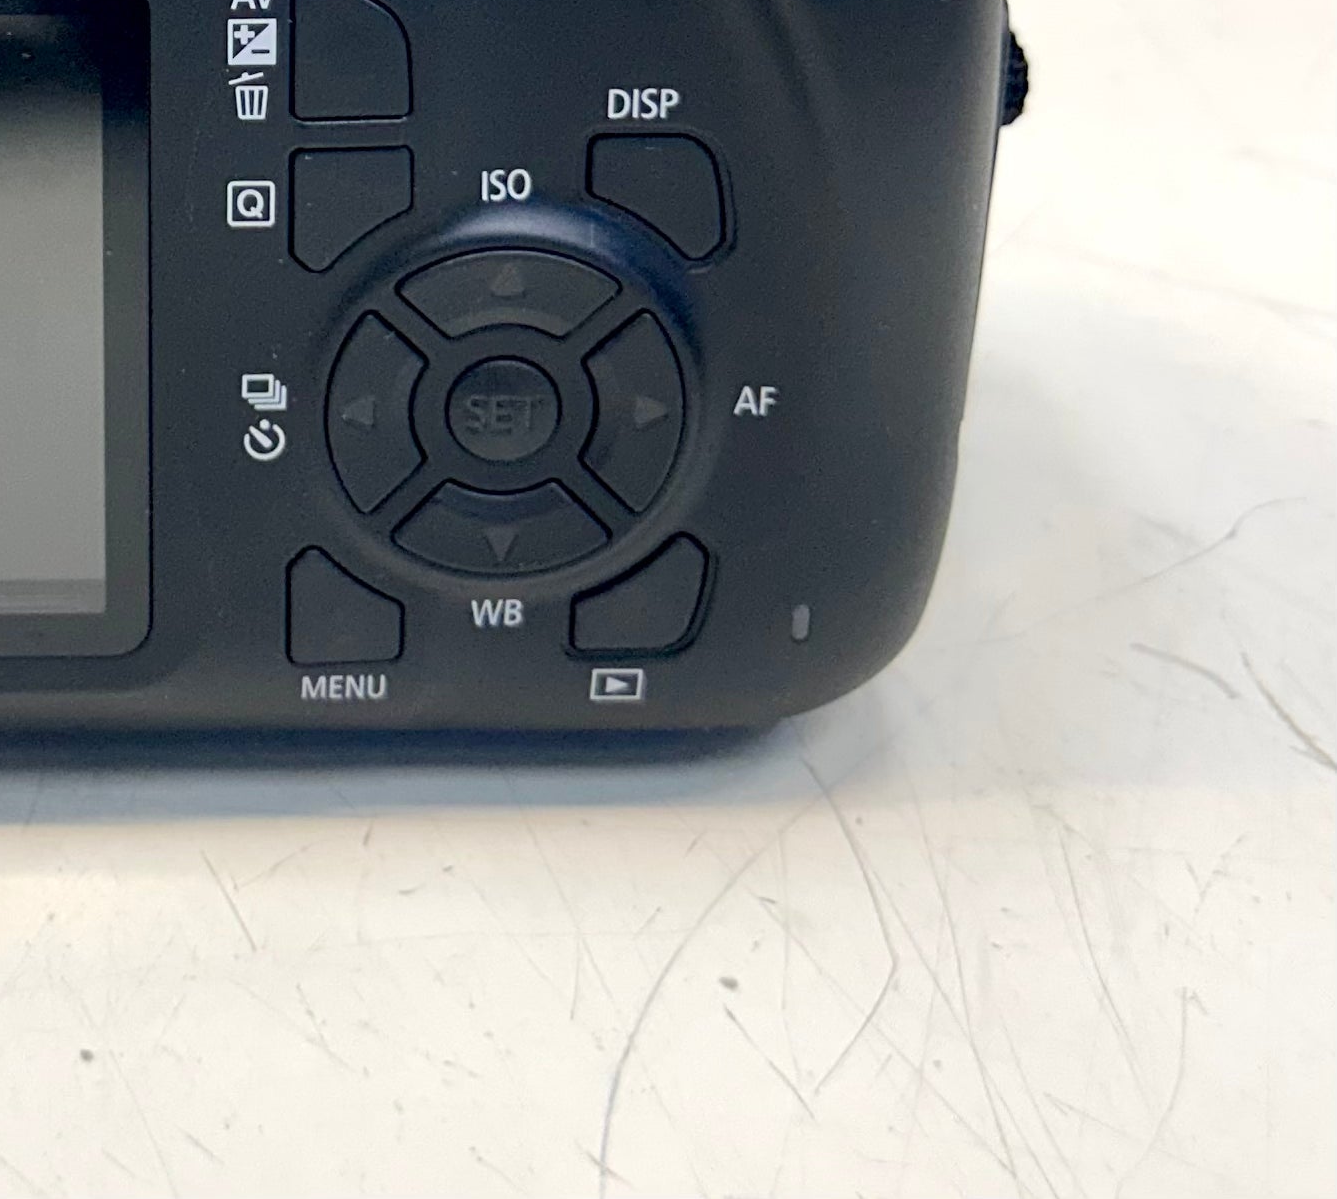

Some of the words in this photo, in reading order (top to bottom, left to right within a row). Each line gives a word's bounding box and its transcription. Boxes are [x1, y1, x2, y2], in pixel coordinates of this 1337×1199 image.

[607, 87, 680, 120] DISP
[481, 168, 532, 201] ISO
[236, 188, 265, 219] Q
[464, 395, 543, 435] SET
[733, 385, 777, 416] AF
[470, 599, 523, 628] WB
[300, 673, 387, 700] MENU
